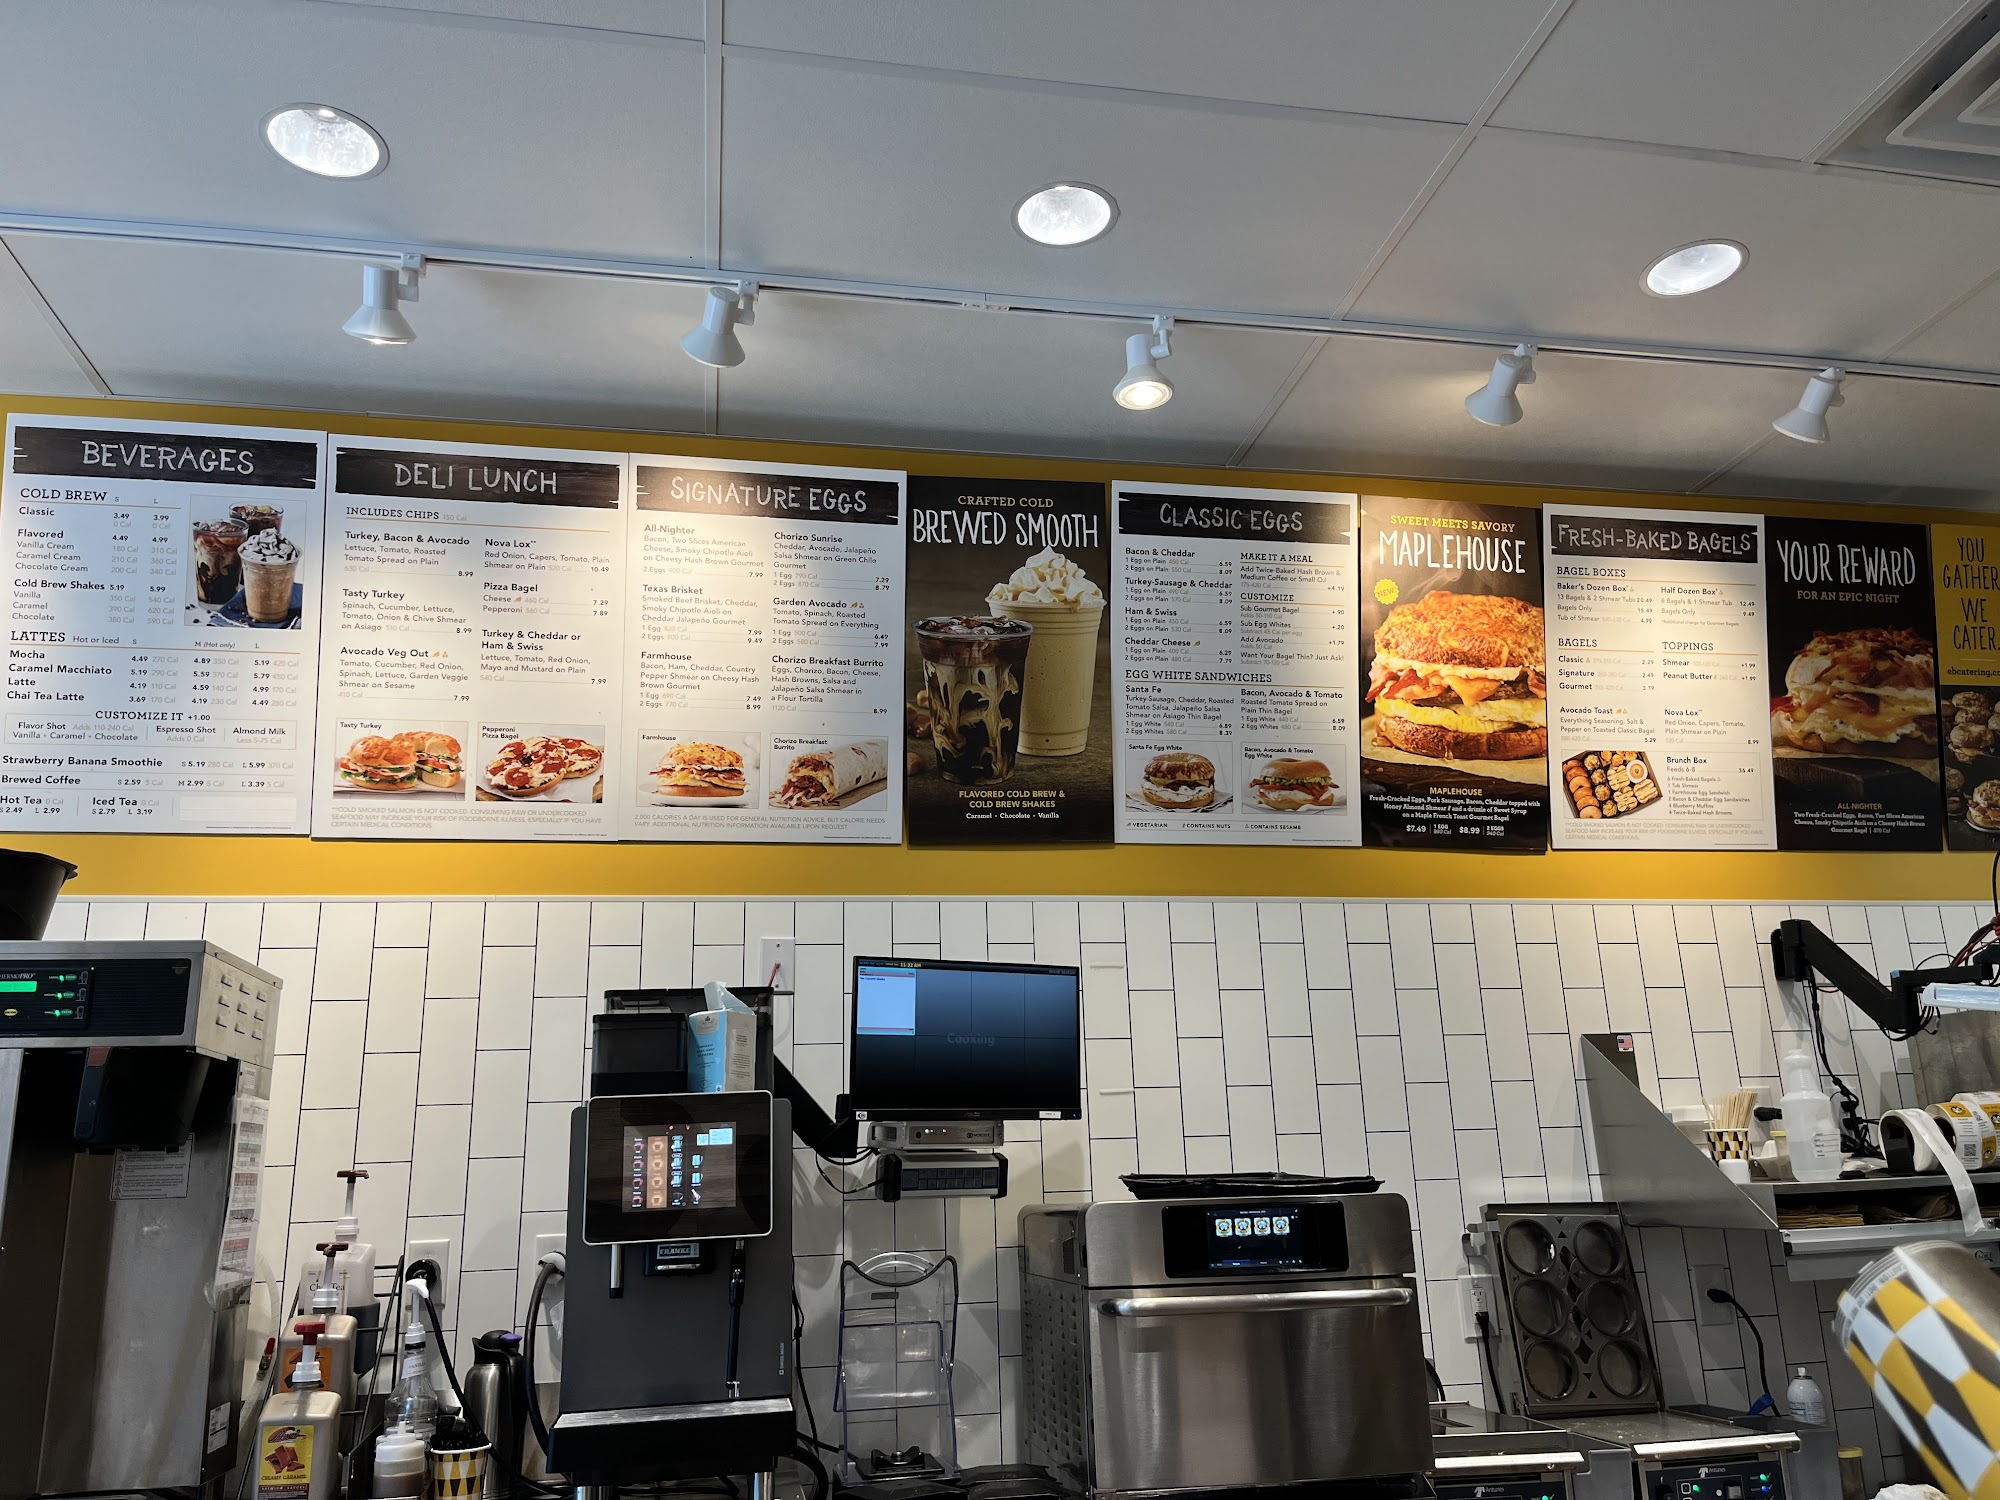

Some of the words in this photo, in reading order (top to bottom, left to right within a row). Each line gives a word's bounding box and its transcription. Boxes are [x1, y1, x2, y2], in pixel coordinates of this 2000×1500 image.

[82, 440, 255, 475] BEVERAGES
[394, 464, 453, 490] DELI
[469, 466, 557, 495] LUNCH
[20, 488, 61, 500] COLD
[65, 490, 108, 502] BREW
[671, 476, 801, 510] SIGNATURE
[809, 488, 867, 515] EGGS
[958, 496, 1016, 507] CRAFTED
[1020, 498, 1054, 508] COLD
[19, 506, 55, 517] Classic
[114, 512, 130, 520] 3.49
[346, 507, 403, 518] INCLUDES
[406, 510, 439, 520] CHIPS
[153, 514, 170, 522] 3.99
[1160, 503, 1242, 530] CLASSIC
[1251, 510, 1303, 534] EGGS
[1391, 515, 1429, 526] SWEET
[1432, 518, 1468, 529] MEETS
[1471, 520, 1515, 532] SAVORY
[18, 528, 64, 539] Flavored
[913, 509, 1007, 545] BREWED
[1016, 513, 1098, 548] SMOOTH
[345, 531, 380, 542] Turkey,
[384, 533, 413, 542] Bacon
[417, 535, 424, 543] &
[428, 536, 470, 545] Avocado
[774, 532, 809, 541] Chorizo
[812, 534, 843, 543] Sunrise
[1558, 524, 1682, 551] FRESH-BAKED
[1687, 531, 1751, 555] BAGELS
[1161, 549, 1195, 558] Cheddar
[1379, 530, 1526, 573] MAPLEHOUSE
[1957, 538, 1984, 563] YOU
[1240, 553, 1265, 561] MAKE
[1269, 554, 1278, 562] IT
[1289, 555, 1313, 563] MEAL
[1777, 540, 1833, 583] YOUR
[1837, 544, 1916, 587] REWARD
[1557, 567, 1590, 576] BAGEL
[1593, 568, 1626, 577] BOXES
[1943, 564, 2000, 590] GATHER
[14, 579, 38, 588] Cold
[41, 580, 67, 589] Brew
[70, 580, 105, 590] Shakes
[484, 582, 508, 591] Pizza
[511, 583, 538, 593] Bagel
[1125, 578, 1187, 588] Turkey-Sausage
[1198, 580, 1232, 589] Cheddar
[343, 589, 369, 599] Tasty
[372, 590, 405, 601] Turkey
[643, 584, 668, 593] Texas
[671, 586, 703, 595] Brisket
[1377, 587, 1397, 597] NEW!
[1240, 593, 1294, 602] CUSTOMIZE
[1797, 591, 1818, 600] FOR
[1821, 591, 1836, 601] AN
[1839, 592, 1863, 602] EPIC
[1866, 594, 1899, 604] NIGHT
[773, 598, 806, 607] Garden
[809, 600, 847, 609] Avocado
[1155, 608, 1177, 616] Swiss
[1961, 598, 1988, 623] WE
[10, 631, 66, 643] LATTES
[482, 630, 514, 640] Turkey
[518, 631, 524, 639] &
[528, 631, 568, 640] Cheddar
[482, 641, 503, 650] Ham
[507, 642, 514, 650] &
[517, 642, 544, 651] Swiss
[1125, 637, 1159, 645] Cheddar
[1161, 638, 1191, 646] Cheese
[1558, 638, 1597, 647] BAGELS
[1662, 642, 1714, 651] TOPPINGS
[10, 650, 45, 660] Mocha
[340, 647, 385, 657] Avocado
[388, 648, 407, 658] Veg
[410, 649, 429, 658] Out
[641, 652, 692, 661] Farmhouse
[772, 656, 806, 665] Chorizo
[809, 657, 851, 666] Breakfast
[854, 658, 884, 667] Burrito
[9, 664, 53, 674] Caramel
[57, 665, 112, 675] Macchiato
[1559, 669, 1594, 677] Signature
[1126, 670, 1149, 679] EGG
[1152, 671, 1192, 680] WHITE
[1195, 672, 1272, 683] SANDWICHES
[1663, 672, 1688, 680] Peanut
[8, 678, 36, 687] Latte
[1126, 685, 1149, 693] Santa
[1241, 689, 1266, 697] Bacon,
[7, 691, 31, 701] Chai
[34, 692, 52, 701] Tea
[56, 692, 84, 701] Latte
[96, 711, 167, 721] CUSTOMIZE
[171, 712, 183, 722] IT
[3, 756, 64, 768] Strawberry
[68, 757, 107, 767] Banana
[111, 758, 163, 768] Smoothie
[2, 775, 42, 785] Brewed
[46, 776, 81, 786] Coffee
[1430, 787, 1482, 796] MAPLEHOUSE
[0, 796, 20, 805] Hot
[24, 796, 42, 806] Tea
[93, 797, 115, 807] Iced
[119, 798, 138, 807] Tea
[1406, 825, 1426, 833] $7.49
[1459, 826, 1480, 834] $8.99
